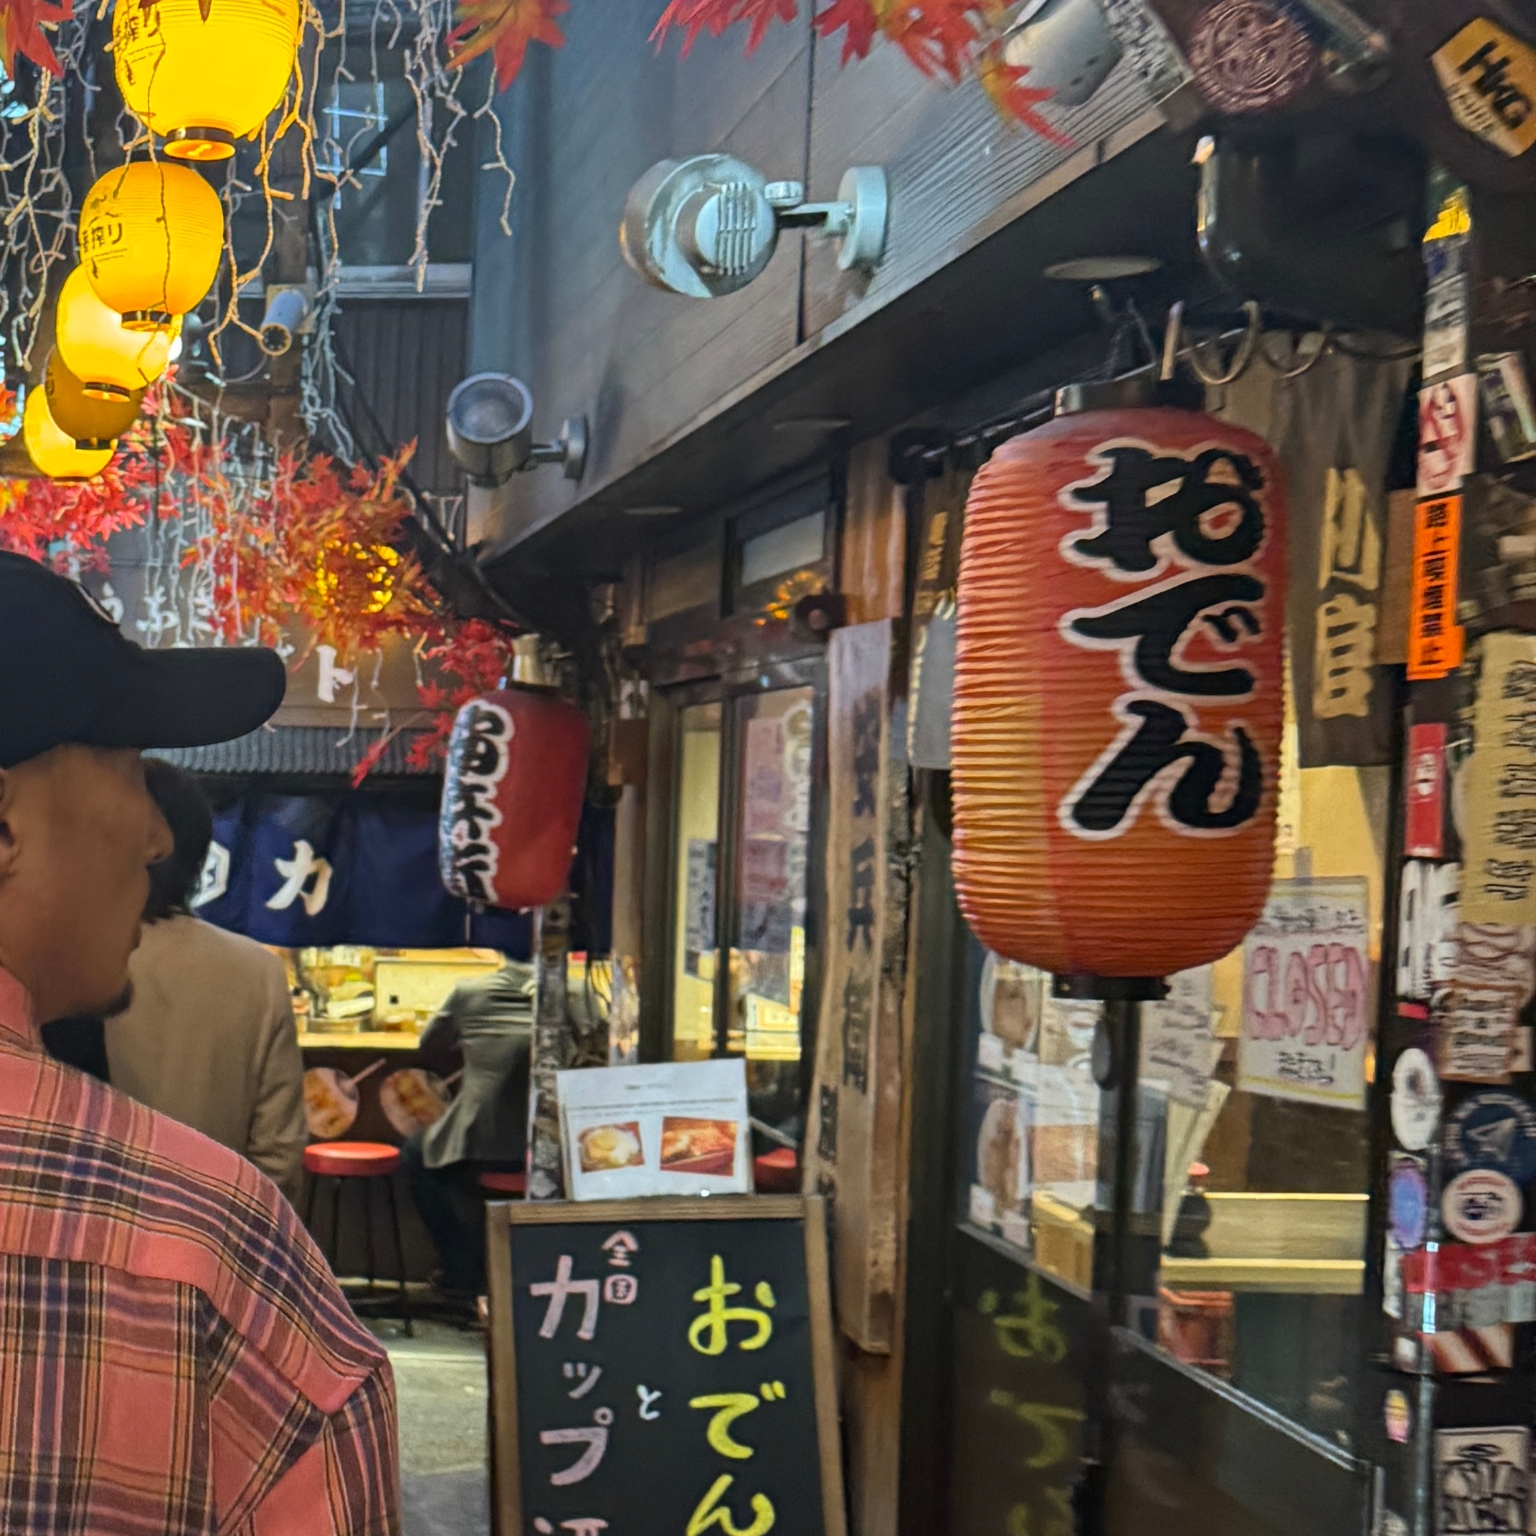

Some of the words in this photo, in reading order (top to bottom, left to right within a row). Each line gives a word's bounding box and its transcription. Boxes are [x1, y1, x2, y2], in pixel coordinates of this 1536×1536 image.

[1061, 440, 1270, 836] おでん
[636, 1384, 662, 1421] と
